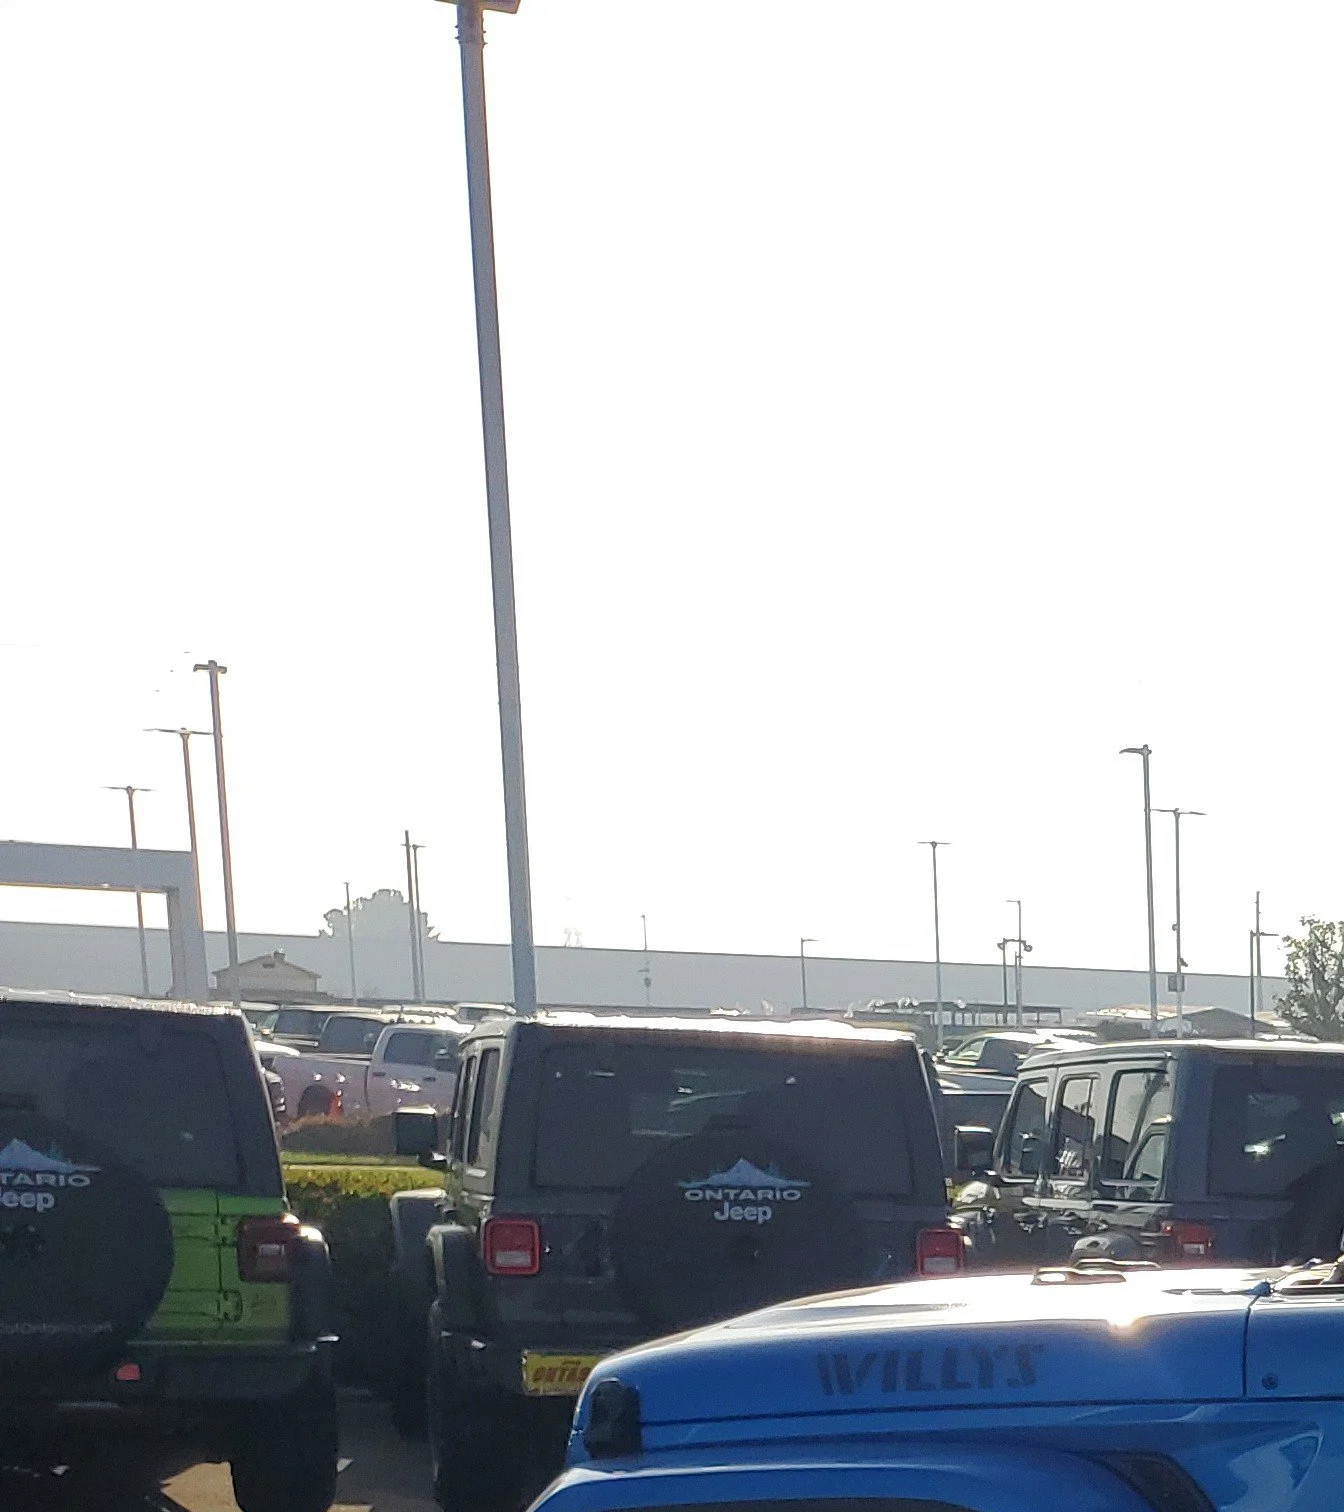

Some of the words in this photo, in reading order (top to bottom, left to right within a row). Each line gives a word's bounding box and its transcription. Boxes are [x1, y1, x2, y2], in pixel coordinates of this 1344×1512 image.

[0, 1184, 55, 1212] eep
[684, 1188, 801, 1201] ONTARIO
[713, 1201, 772, 1224] Jeep
[816, 1344, 1045, 1396] WILLYS
